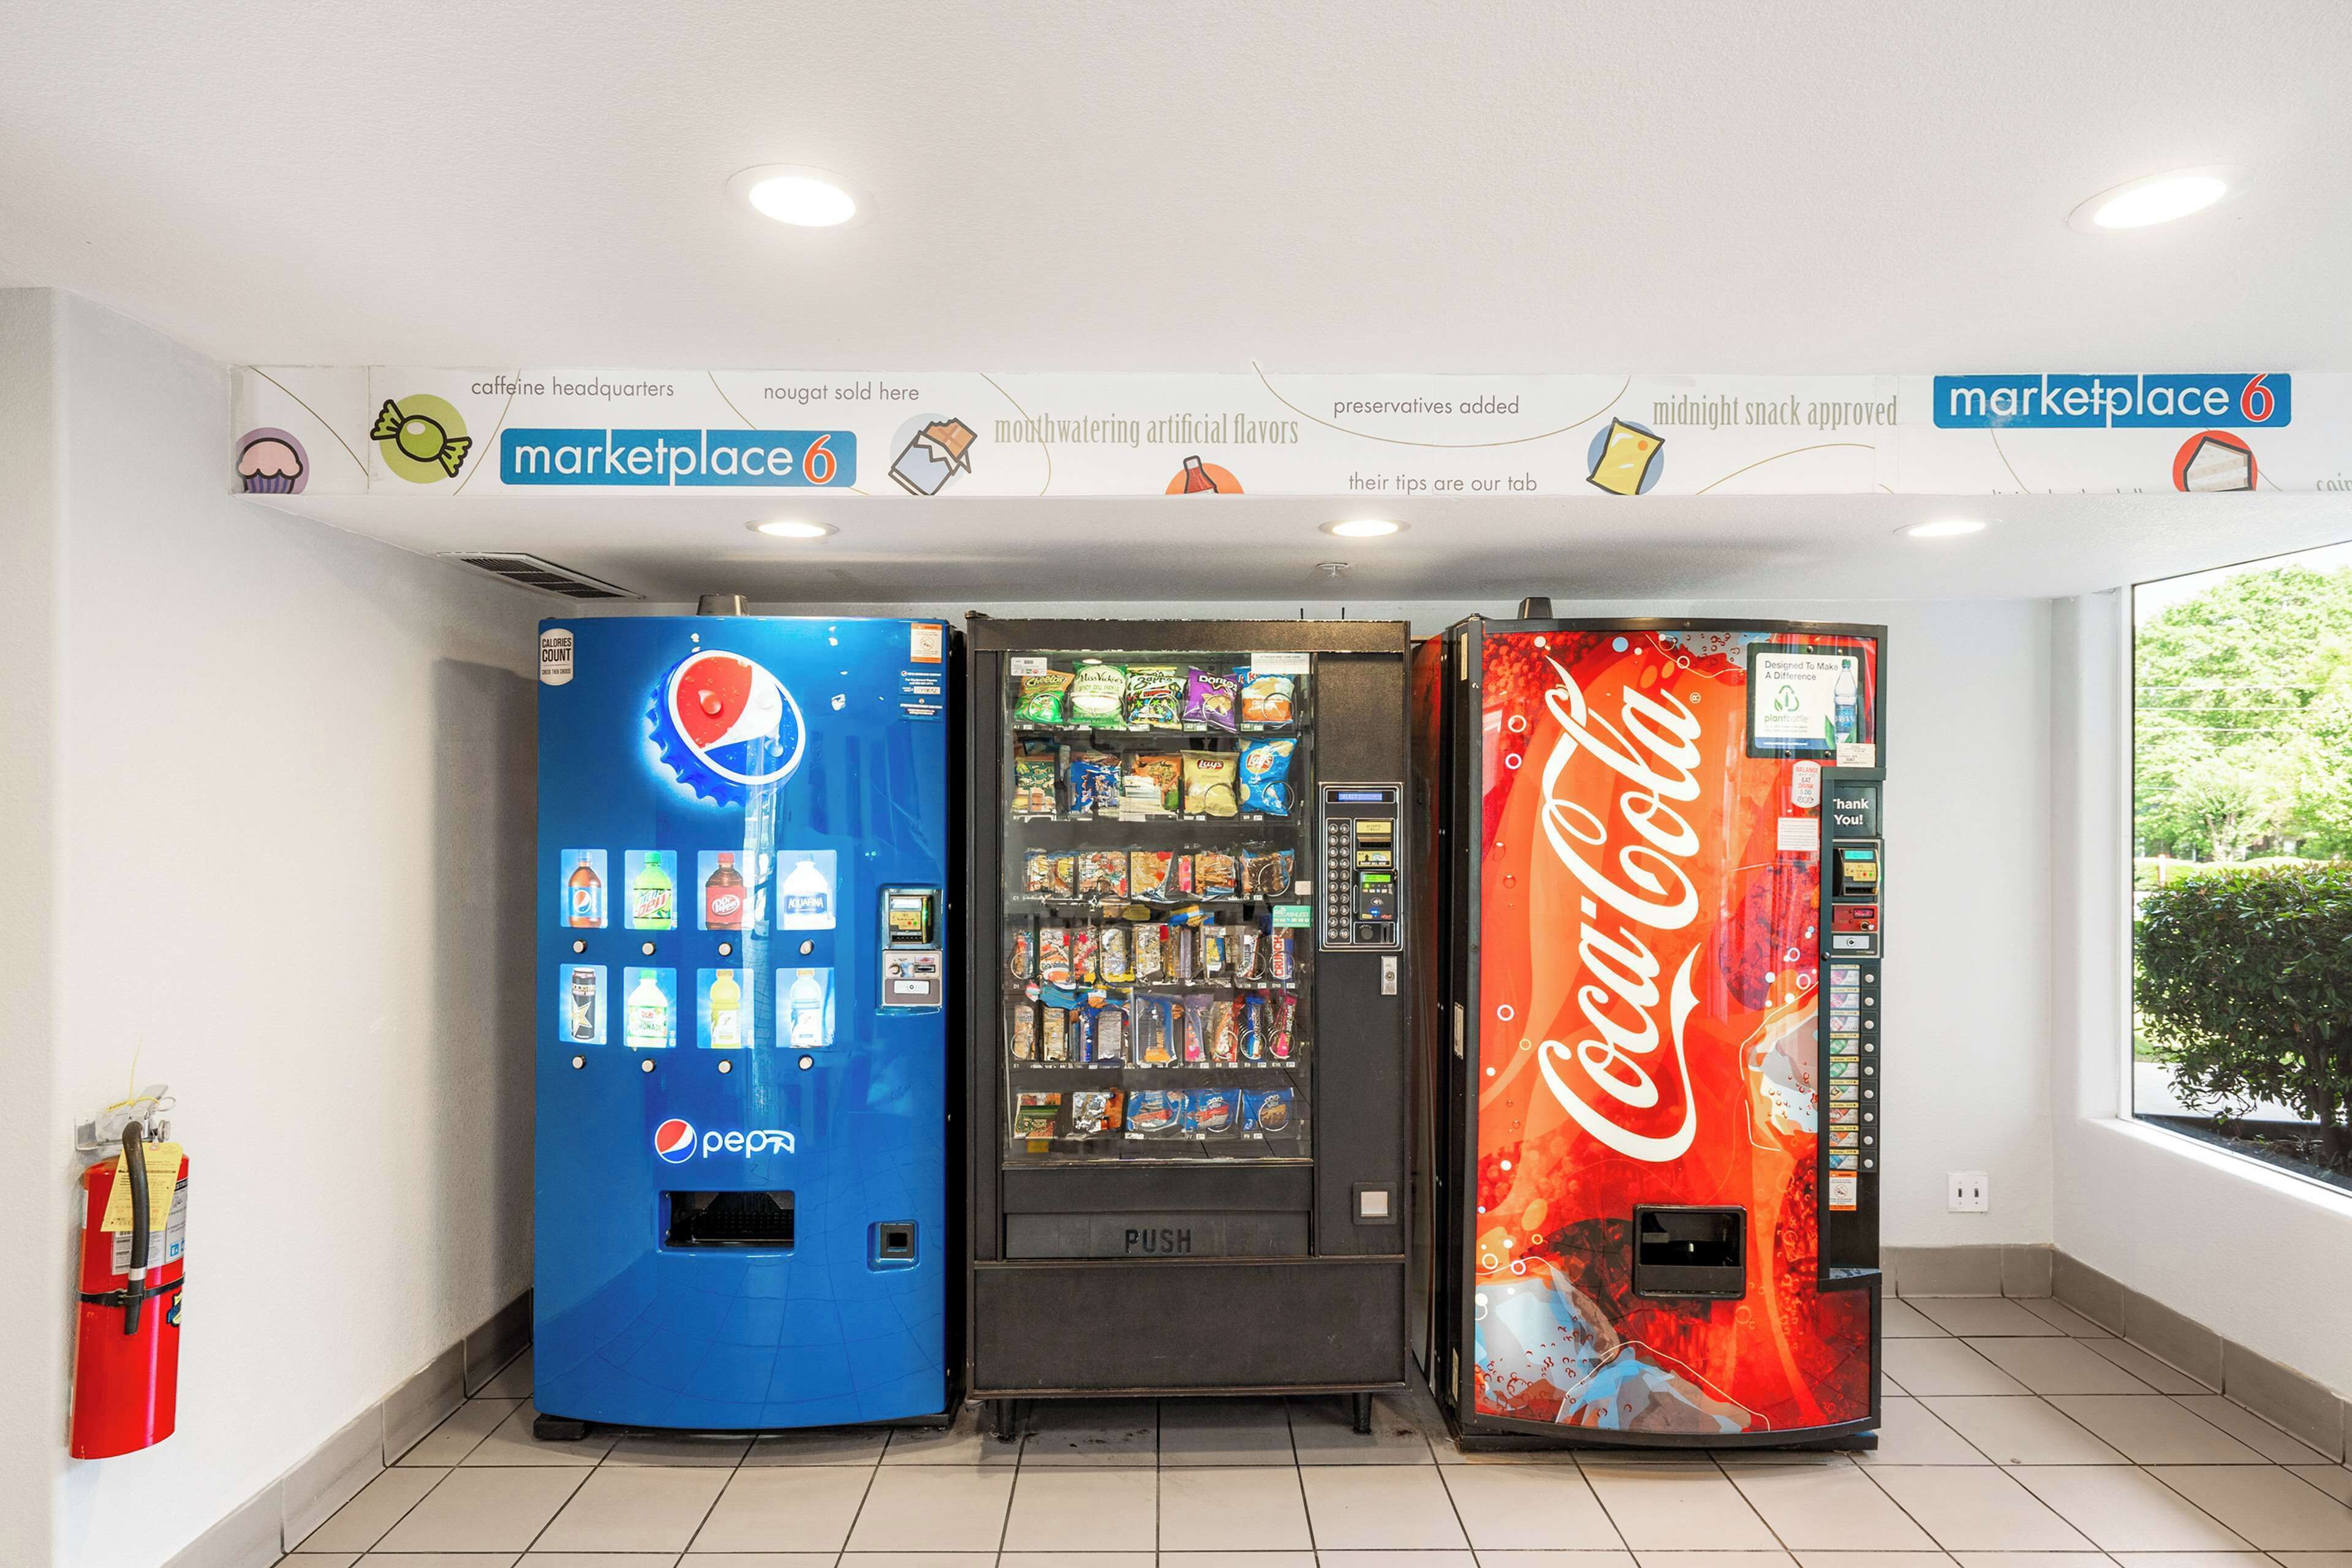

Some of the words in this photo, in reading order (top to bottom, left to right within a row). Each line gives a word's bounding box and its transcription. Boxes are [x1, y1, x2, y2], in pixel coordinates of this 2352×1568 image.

[471, 376, 545, 396] caffeine
[553, 377, 674, 401] headquarters
[765, 384, 828, 404] nougat
[834, 382, 871, 401] sold
[880, 383, 919, 401] here
[1334, 397, 1453, 419] preservatives
[1460, 395, 1519, 415] added
[1950, 374, 2229, 429] marketplace
[2239, 374, 2275, 423] 6
[1653, 394, 1739, 431] midnight
[1745, 394, 1801, 426] snack
[1808, 395, 1897, 431] approved
[994, 413, 1141, 448] mouthwatering
[1147, 413, 1228, 445] artificial
[1233, 413, 1299, 445] flavors
[515, 429, 793, 486] marketplace
[803, 434, 838, 485] 6
[1349, 473, 1390, 492] their
[1396, 473, 1427, 496] tips
[1434, 477, 1464, 492] are
[1472, 478, 1502, 492] our
[1508, 473, 1538, 492] tab
[542, 638, 572, 648] CALORIES
[542, 648, 572, 662] COUNT
[1764, 660, 1804, 671] Designed
[1817, 662, 1839, 671] Make
[1026, 676, 1065, 686] Cheetos
[1080, 673, 1098, 682] Miss
[1198, 674, 1238, 692] Doritos
[1774, 671, 1817, 680] Difference
[1764, 714, 1808, 725] plantbottle
[1834, 814, 1863, 825] You!
[714, 899, 739, 913] Pepper
[723, 896, 732, 905] Dr
[788, 897, 824, 910] AQUAFINA
[1538, 654, 1702, 1163] Coca-Cola
[1273, 934, 1284, 977] CRUNCH
[1125, 1229, 1191, 1254] PUSH
